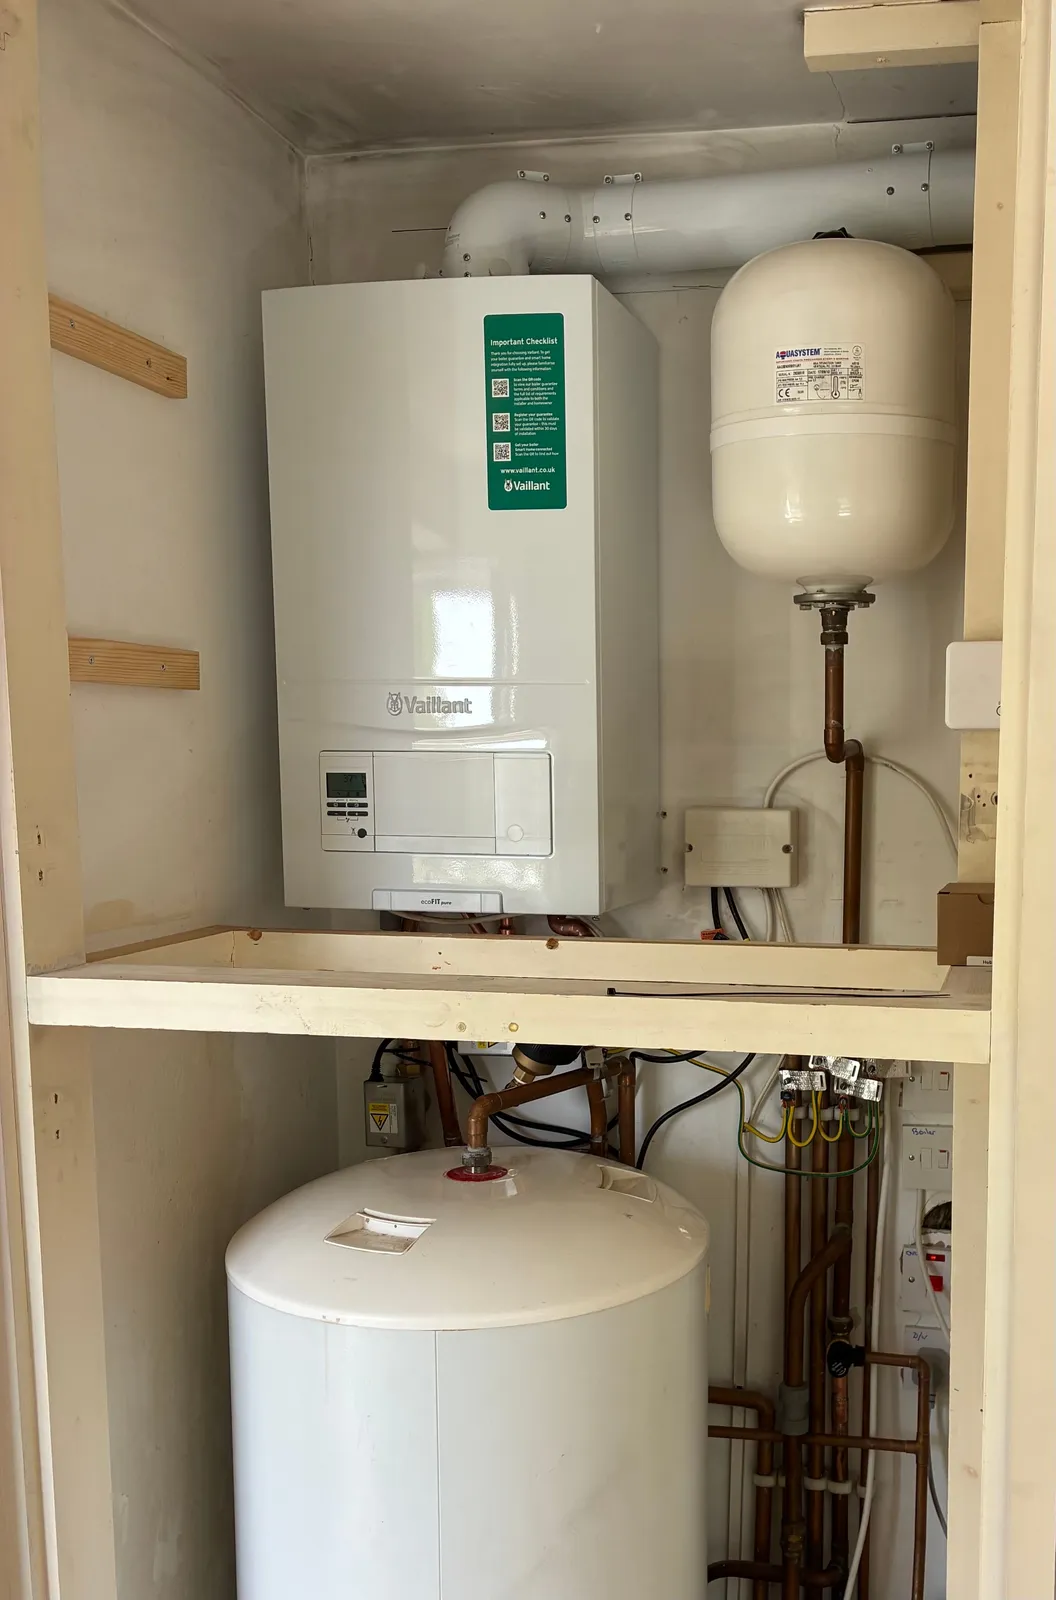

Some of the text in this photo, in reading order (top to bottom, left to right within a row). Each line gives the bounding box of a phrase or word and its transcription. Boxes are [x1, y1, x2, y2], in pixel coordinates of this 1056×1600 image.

[490, 338, 524, 347] Important
[776, 348, 820, 359] AQUASYSTEM
[513, 481, 550, 490] Vaillant
[404, 696, 472, 713] Vaillant
